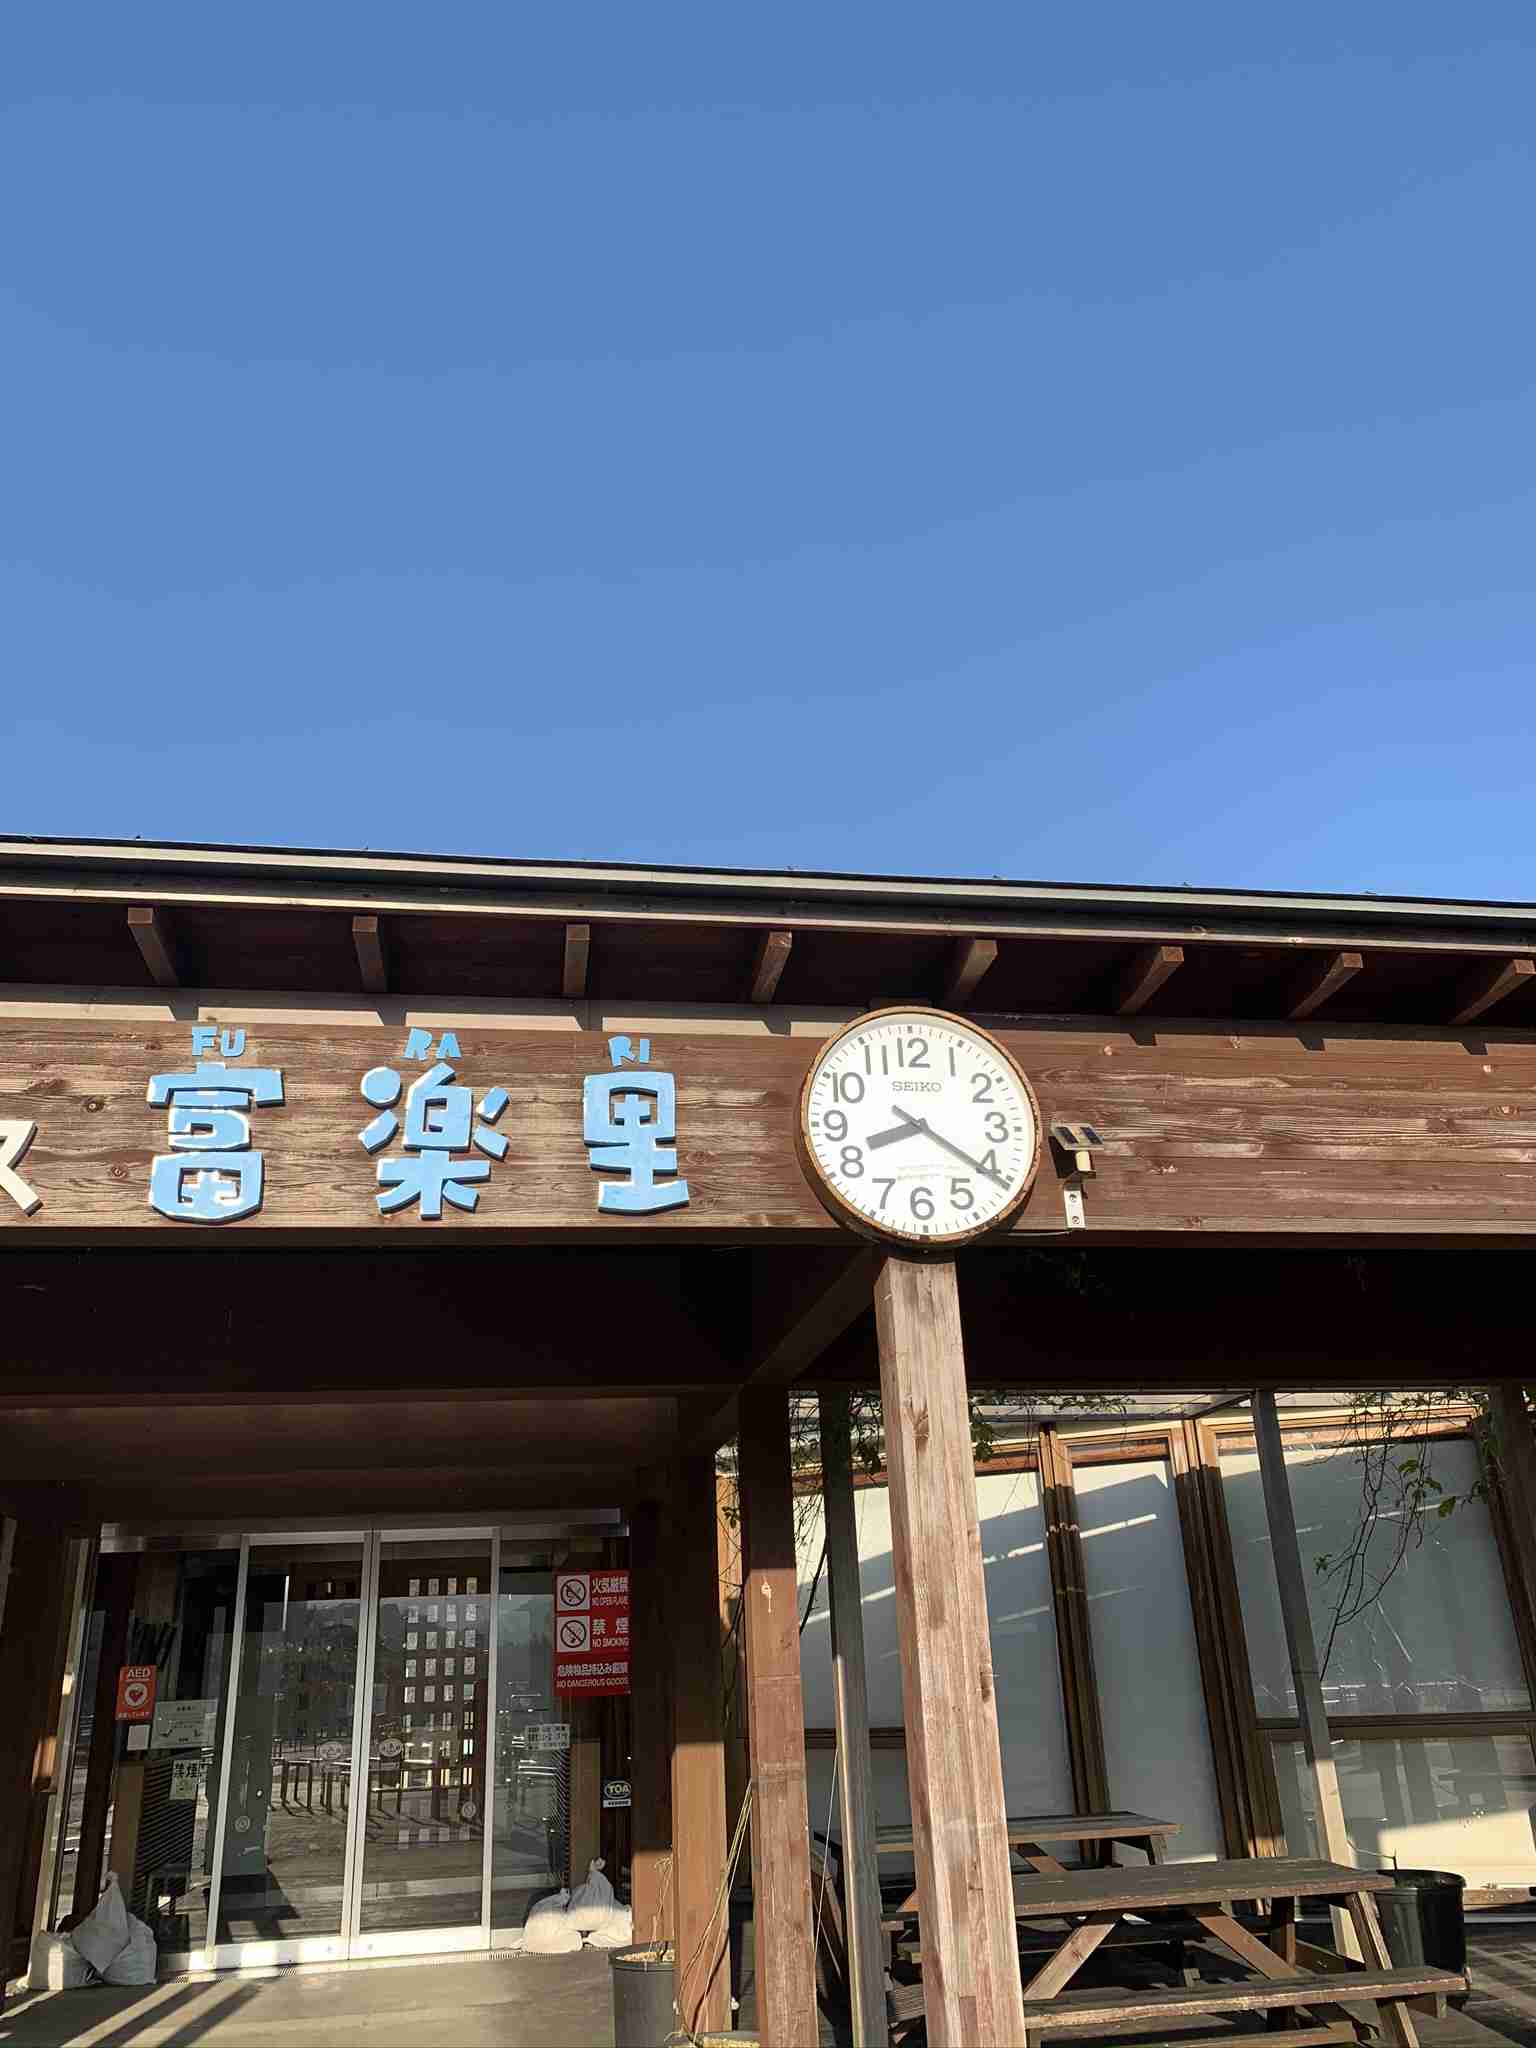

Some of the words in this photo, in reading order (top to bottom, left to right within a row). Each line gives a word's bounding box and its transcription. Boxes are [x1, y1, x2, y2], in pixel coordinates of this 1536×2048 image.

[191, 1025, 246, 1058] FU
[404, 1027, 462, 1061] RA
[608, 1035, 651, 1067] RI
[864, 1044, 888, 1075] 11
[897, 1038, 930, 1068] 12
[948, 1046, 956, 1077] 1
[832, 1072, 865, 1104] 10
[891, 1081, 942, 1092] SEIKO
[970, 1073, 994, 1103] 2
[823, 1110, 848, 1142] 9
[984, 1112, 1009, 1143] 3
[147, 1062, 690, 1225] 富楽里
[840, 1145, 864, 1178] 8
[976, 1149, 1001, 1177] 4
[872, 1178, 896, 1209] 7
[910, 1187, 935, 1220] 6
[950, 1178, 974, 1210] 5
[592, 1639, 601, 1648] NO
[128, 1668, 151, 1679] AED
[609, 1784, 629, 1793] TOA
